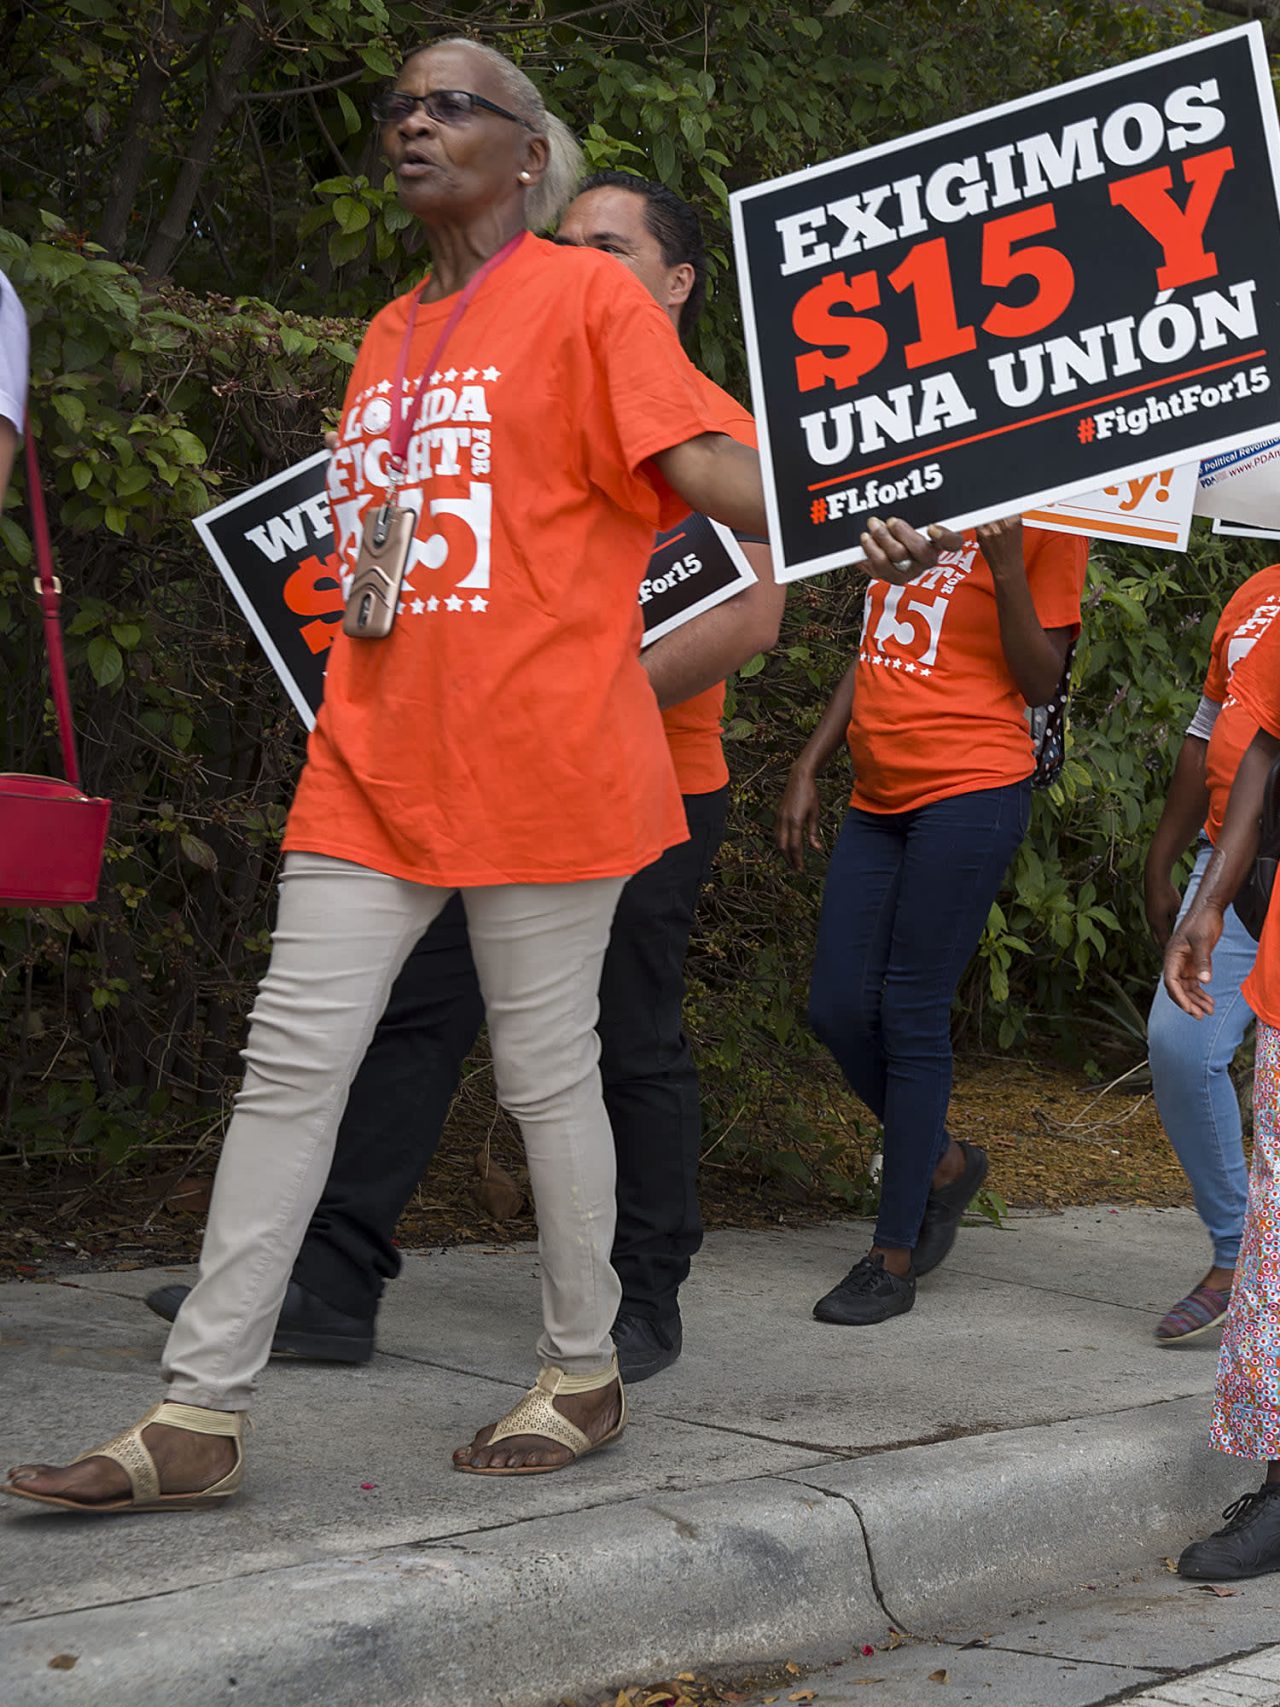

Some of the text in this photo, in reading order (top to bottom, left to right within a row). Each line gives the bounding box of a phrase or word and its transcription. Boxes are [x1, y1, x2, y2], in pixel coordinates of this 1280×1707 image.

[775, 79, 1226, 277] EXIGIMOS
[792, 147, 1235, 393] $15 Y
[800, 280, 1259, 466] UNA UNIÓN
[810, 367, 1271, 525] #FLfor15 #FightFor15
